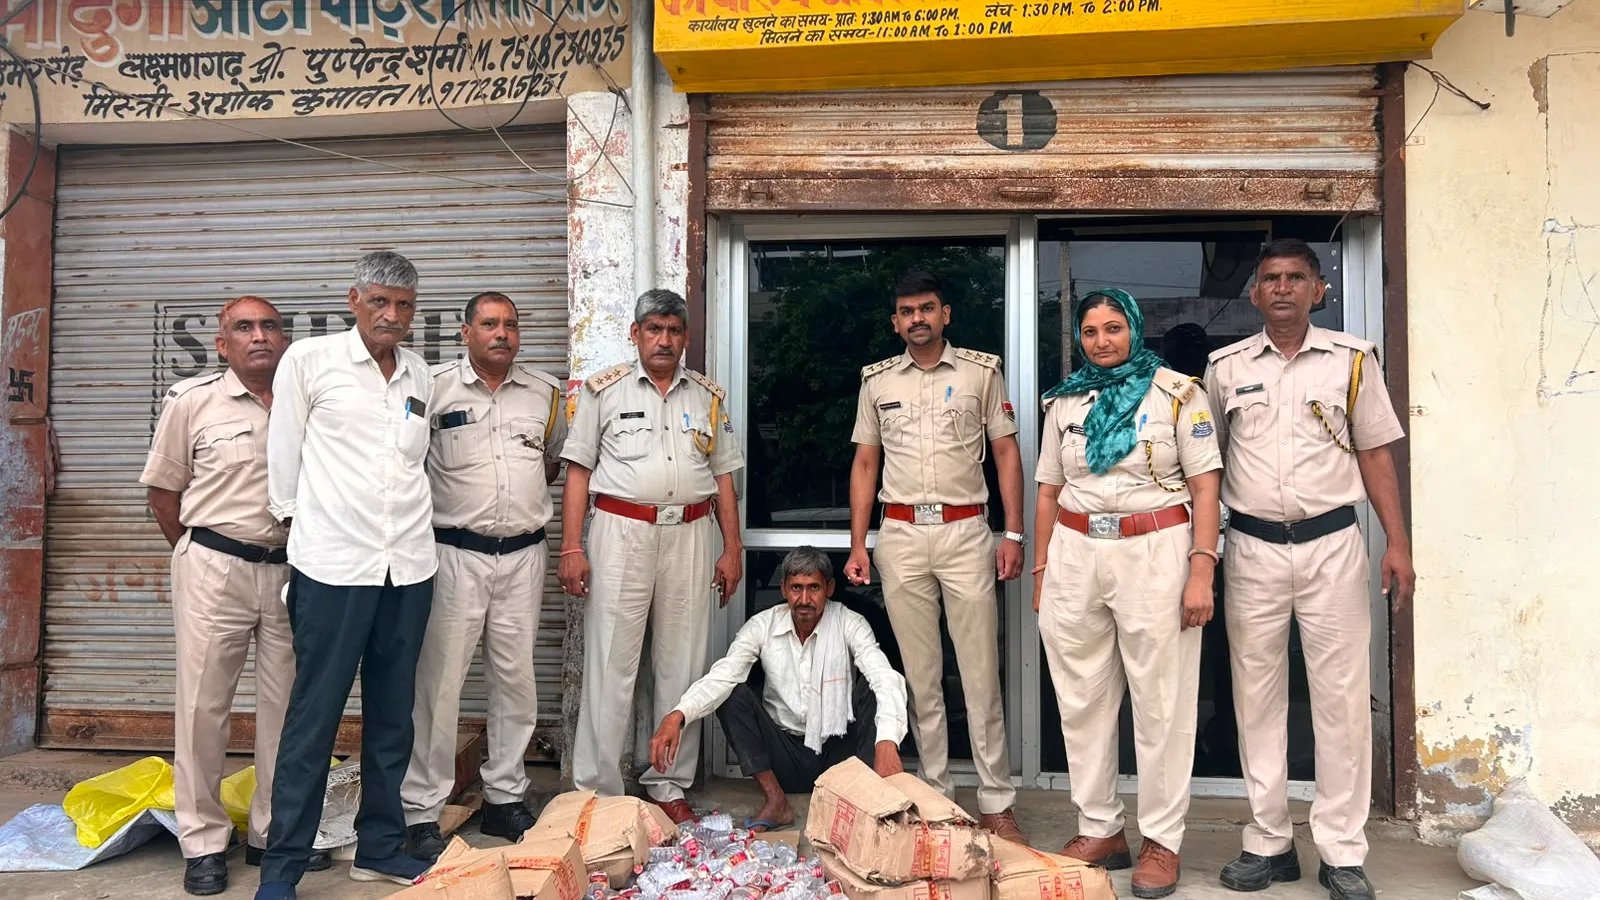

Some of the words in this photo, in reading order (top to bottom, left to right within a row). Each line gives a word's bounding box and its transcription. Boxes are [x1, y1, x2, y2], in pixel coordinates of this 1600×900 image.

[688, 15, 740, 32] कार्यालय
[780, 15, 797, 28] का
[1022, 4, 1049, 18] 1:30
[1102, 0, 1135, 14] 2:00
[805, 30, 825, 42] का
[910, 25, 931, 37] AM
[953, 23, 984, 36] 1:00
[998, 94, 1023, 145] 1
